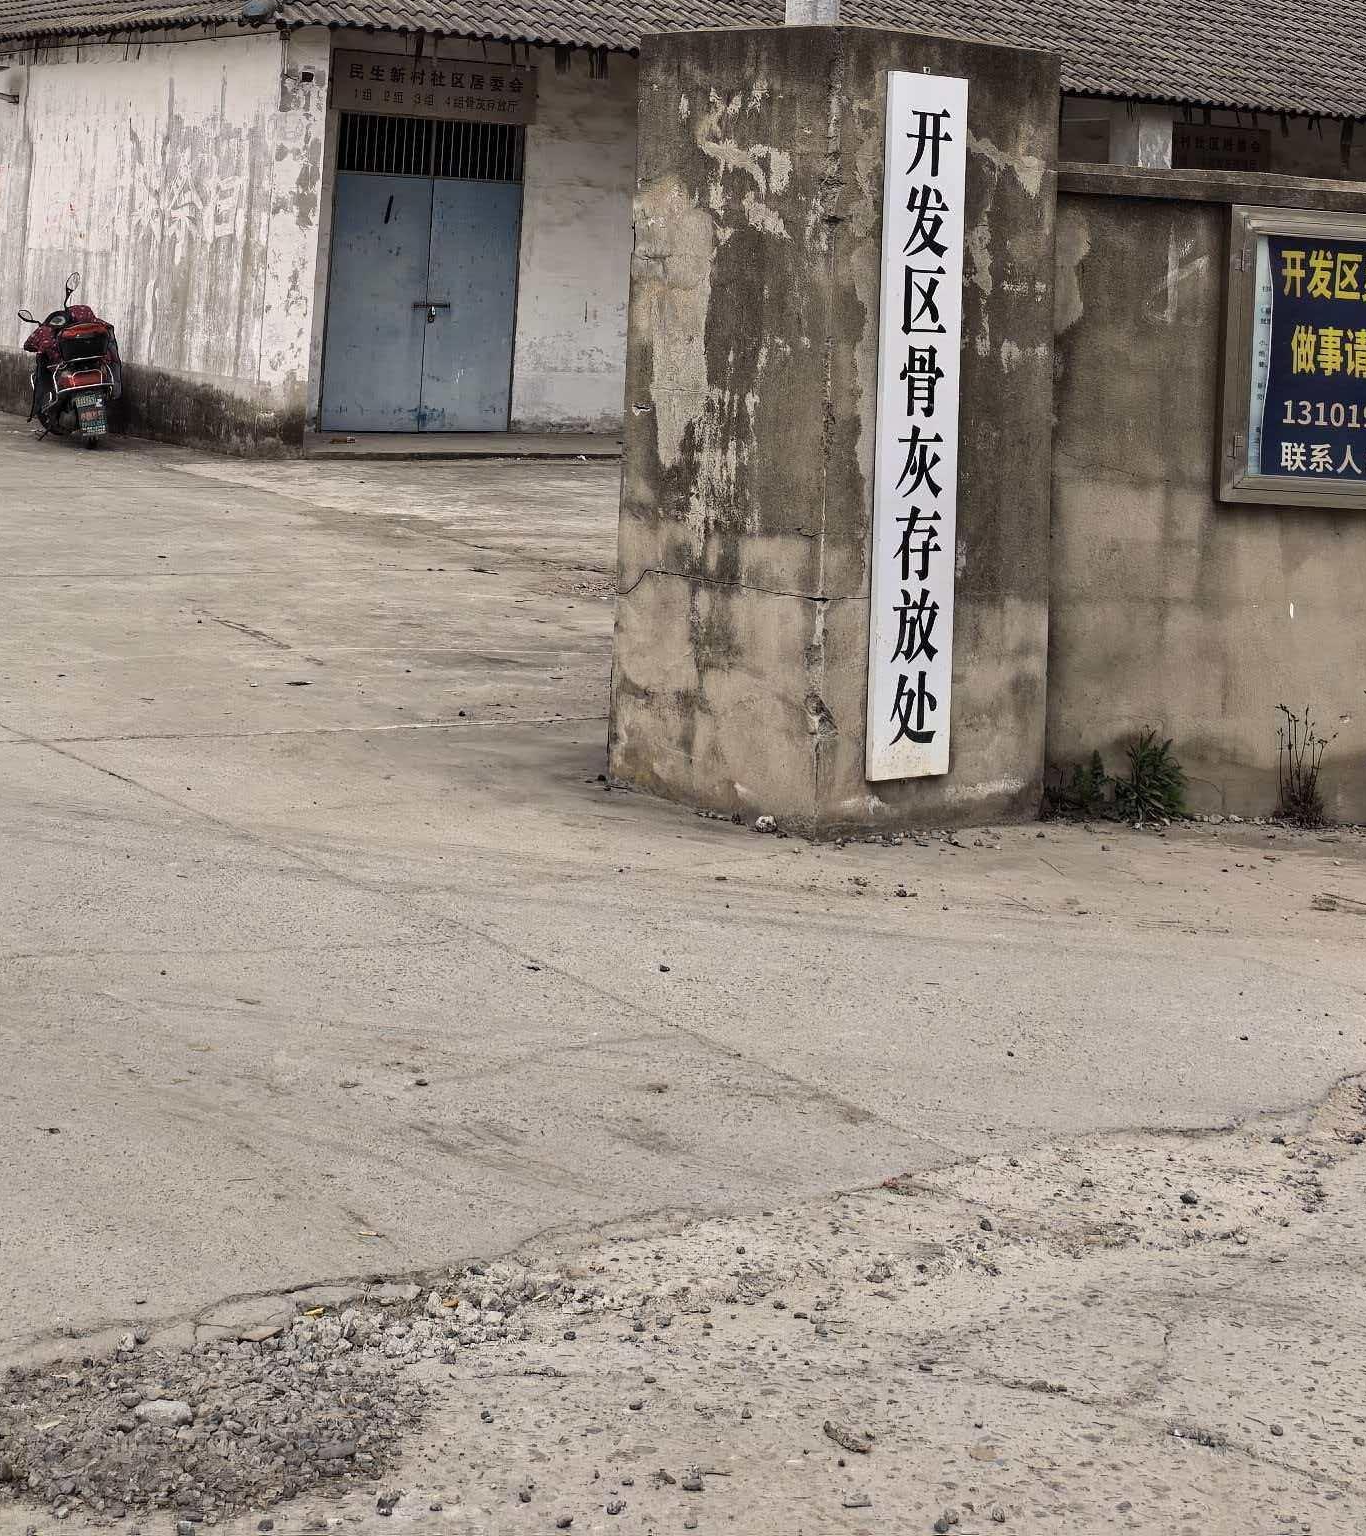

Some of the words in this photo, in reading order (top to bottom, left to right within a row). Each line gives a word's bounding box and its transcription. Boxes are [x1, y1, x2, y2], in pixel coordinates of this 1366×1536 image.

[889, 108, 953, 746] 开发区骨灰存放处
